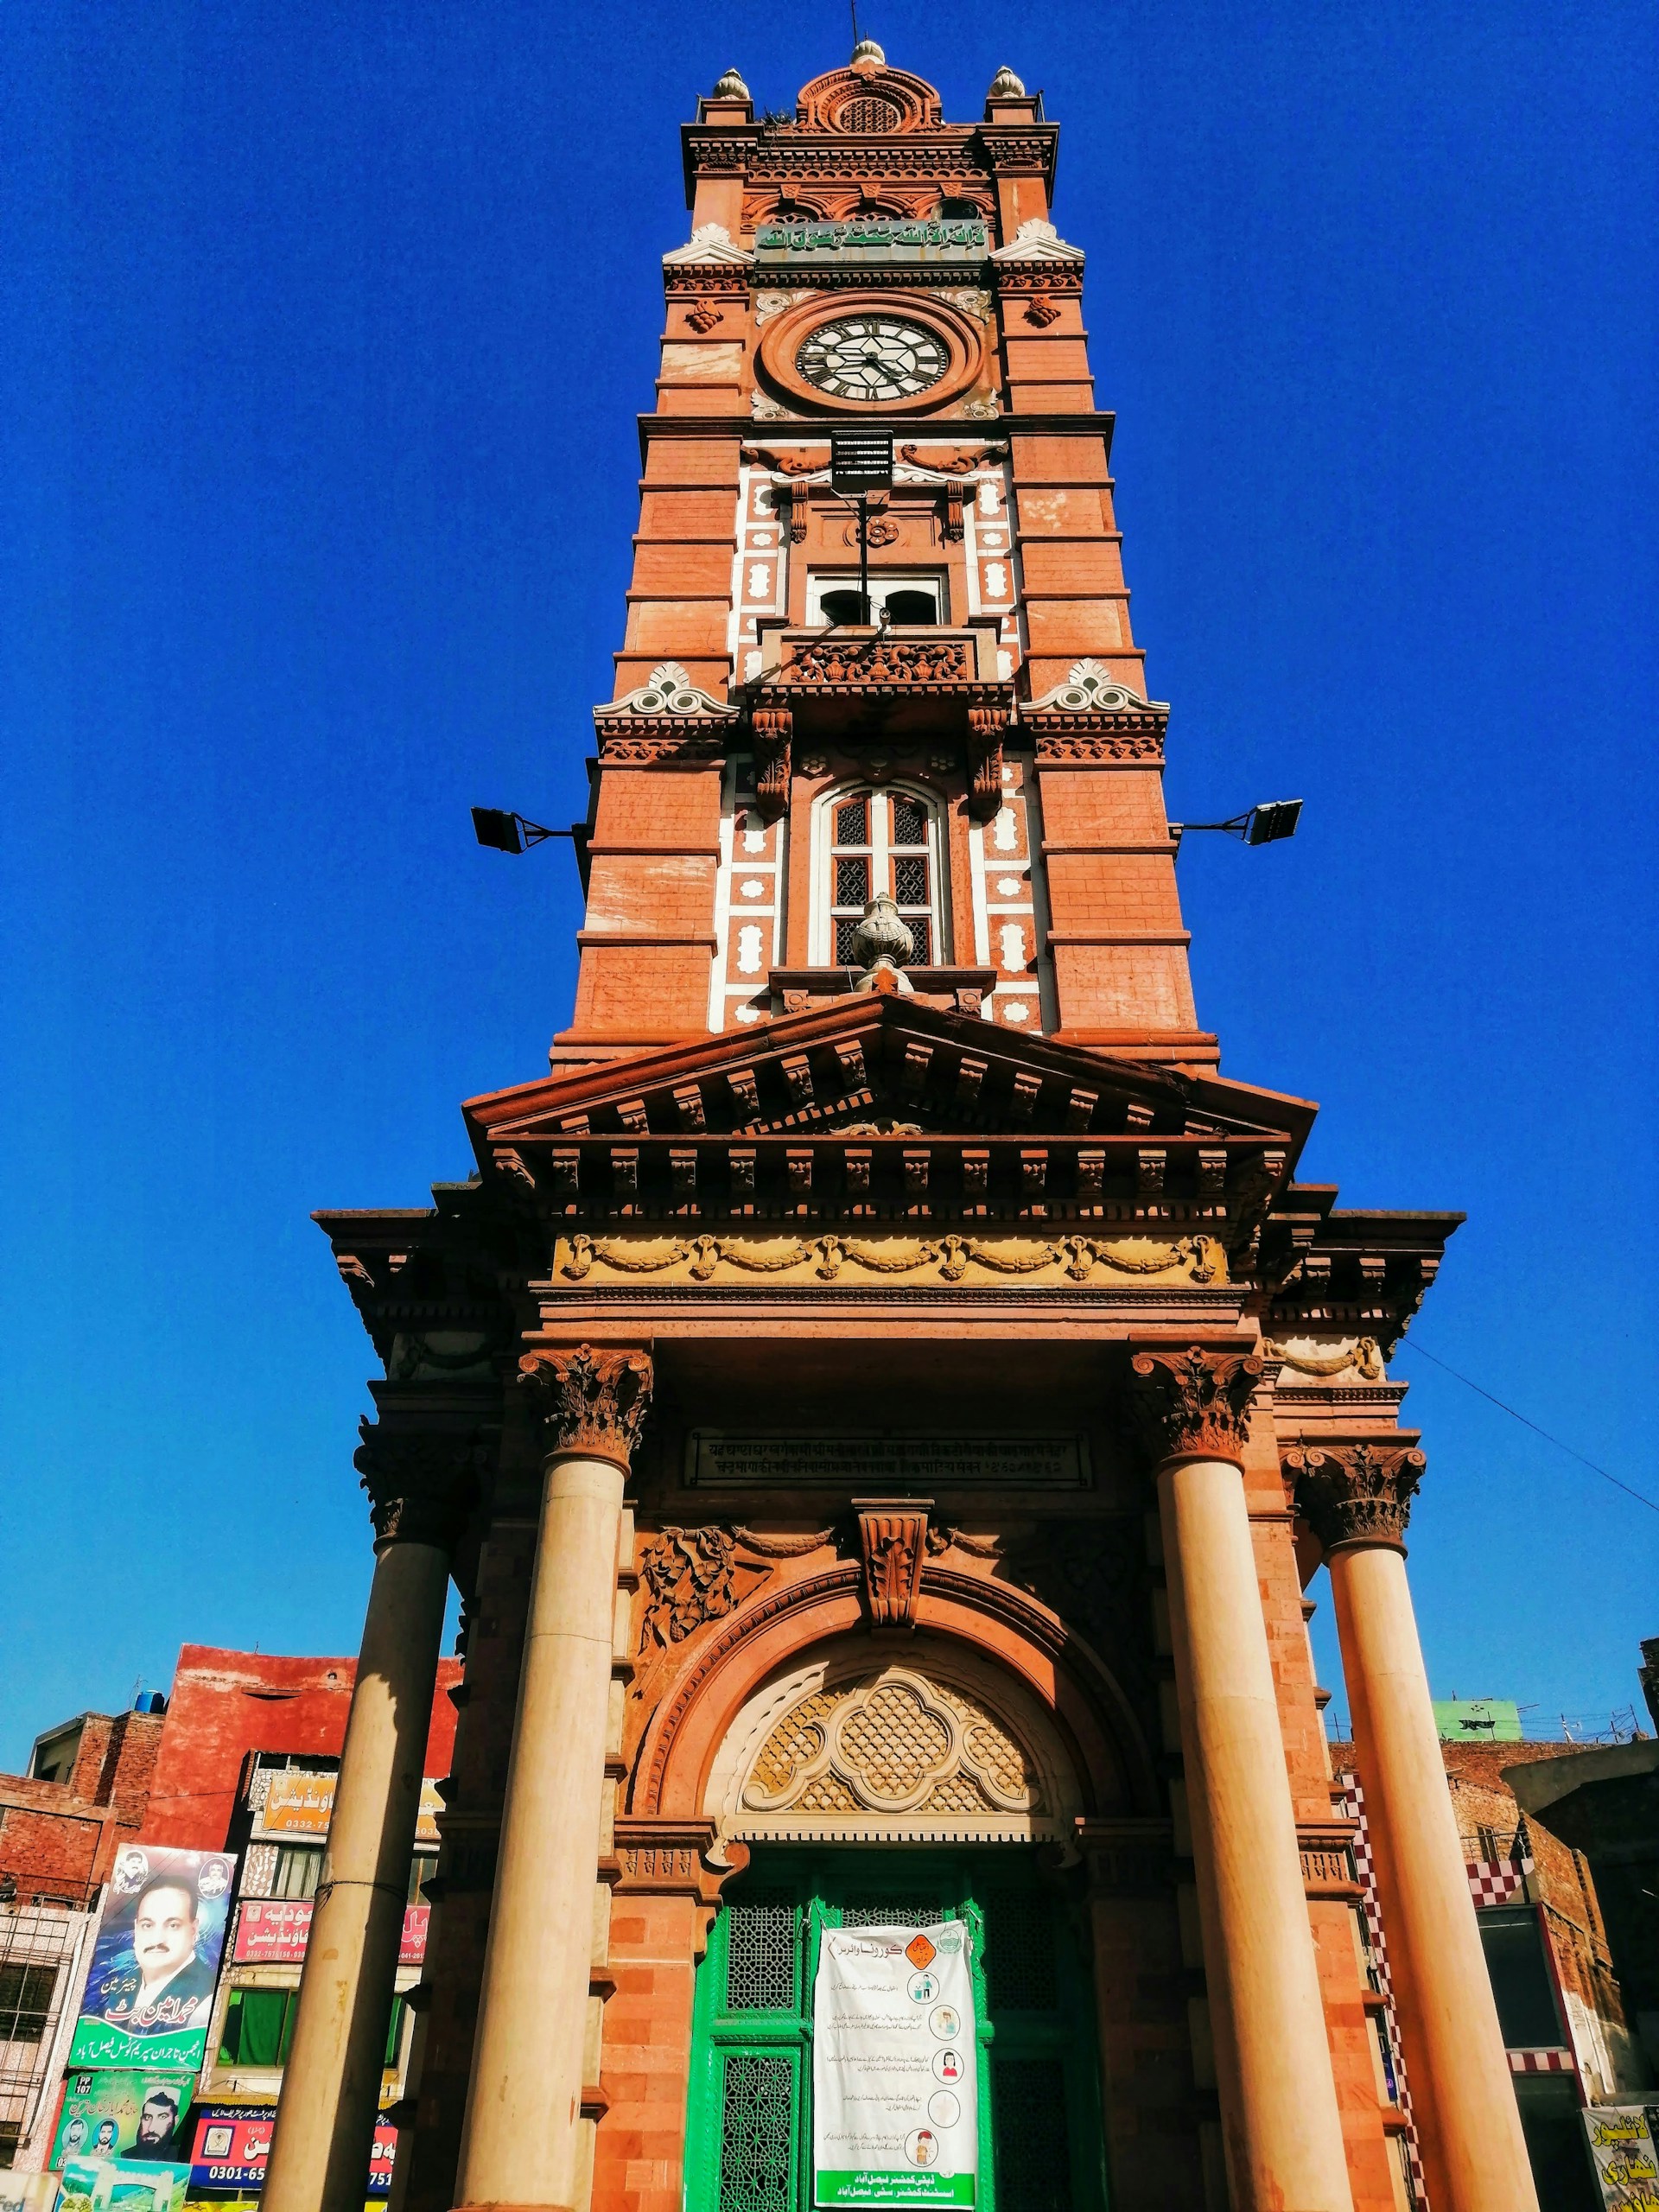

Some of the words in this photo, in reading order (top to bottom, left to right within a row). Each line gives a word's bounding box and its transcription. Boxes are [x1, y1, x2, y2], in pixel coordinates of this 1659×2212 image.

[79, 2075, 91, 2085] PP
[76, 2085, 91, 2094] 107
[209, 2165, 265, 2181] 0301-65
